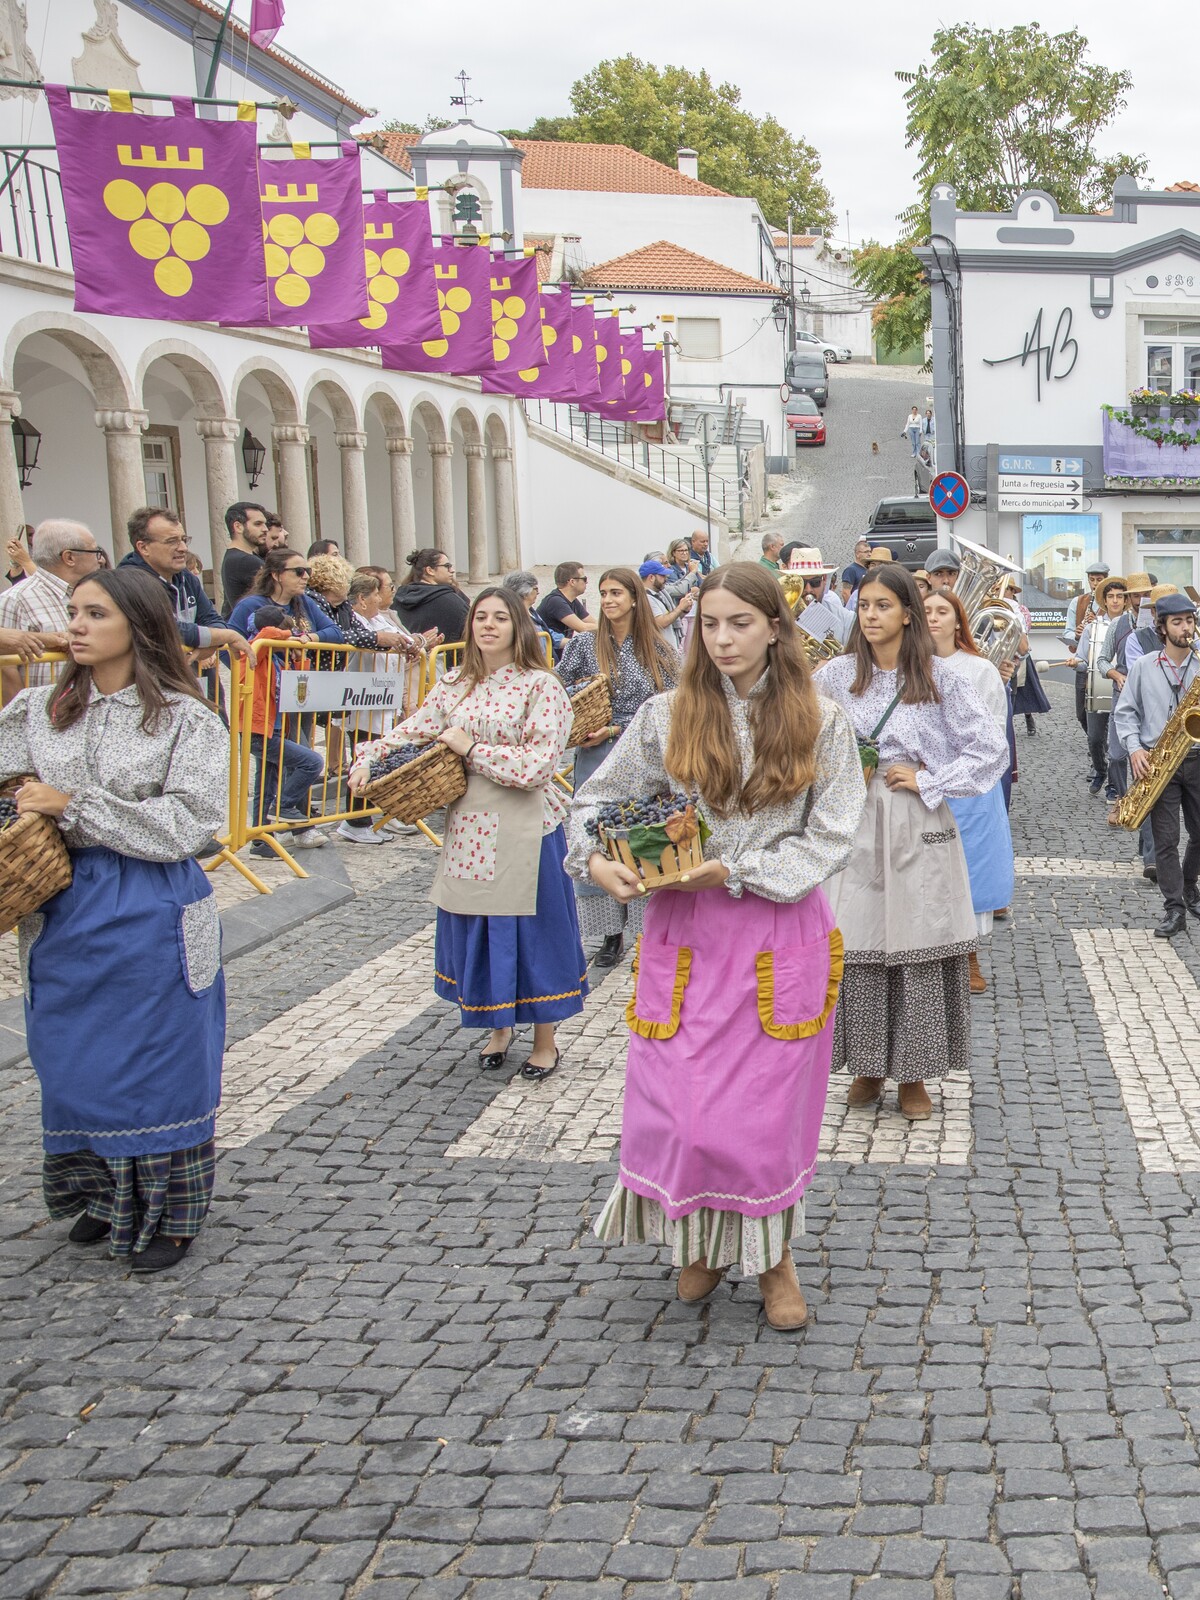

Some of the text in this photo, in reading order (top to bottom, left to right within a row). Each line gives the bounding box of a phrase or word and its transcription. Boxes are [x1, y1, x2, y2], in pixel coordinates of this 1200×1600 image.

[1001, 458, 1035, 471] G.N.R.
[1001, 479, 1021, 488] Junta
[1030, 479, 1065, 490] freguesia
[1032, 499, 1065, 508] municipal
[341, 687, 394, 706] Palmela
